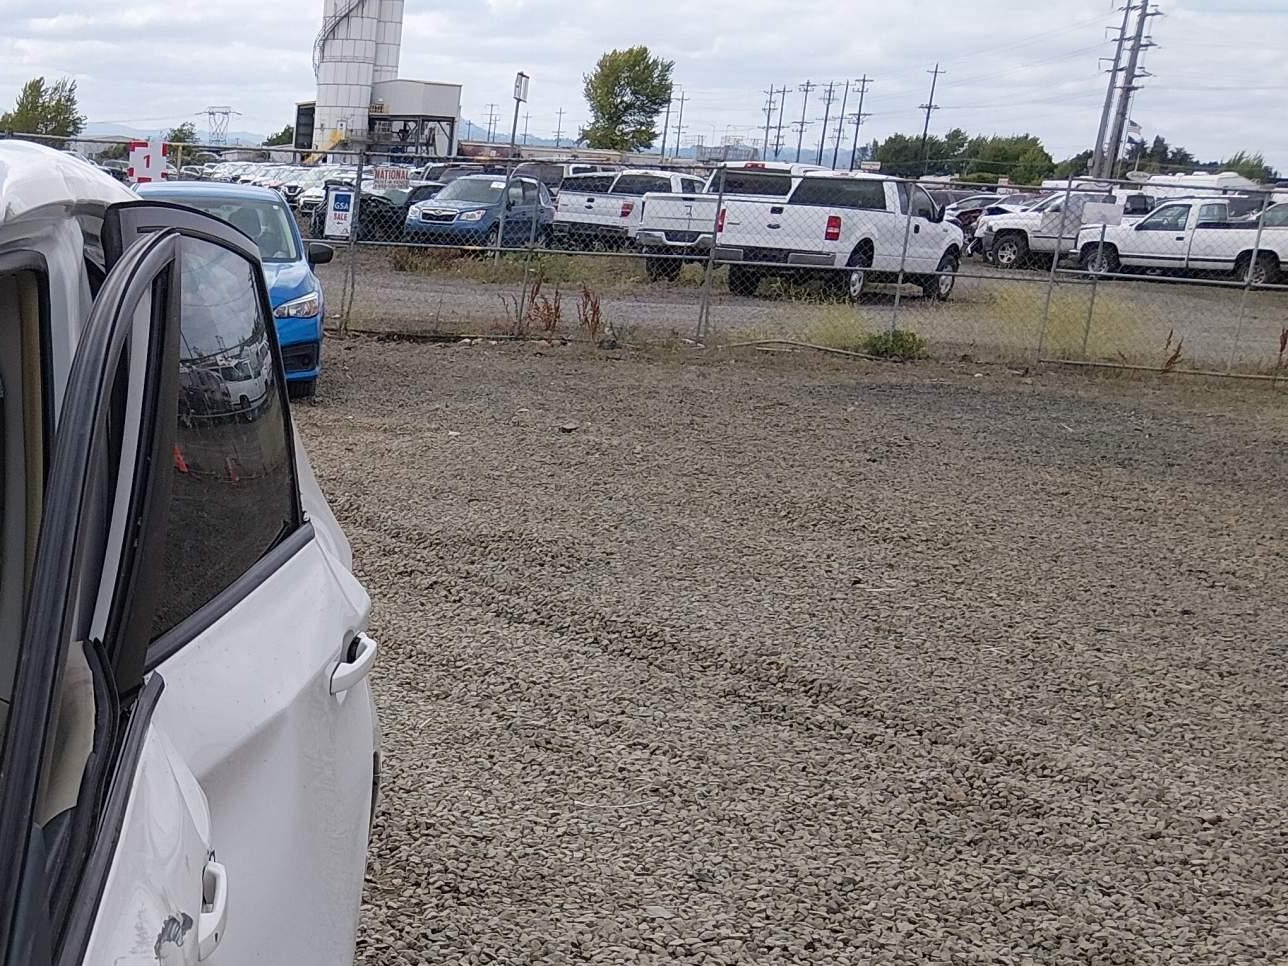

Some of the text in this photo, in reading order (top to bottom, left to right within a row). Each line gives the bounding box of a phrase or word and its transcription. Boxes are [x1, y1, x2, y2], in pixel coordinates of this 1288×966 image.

[143, 154, 150, 169] 1
[374, 168, 409, 180] NATIONAL
[334, 202, 349, 210] GSA
[333, 213, 348, 221] SALE
